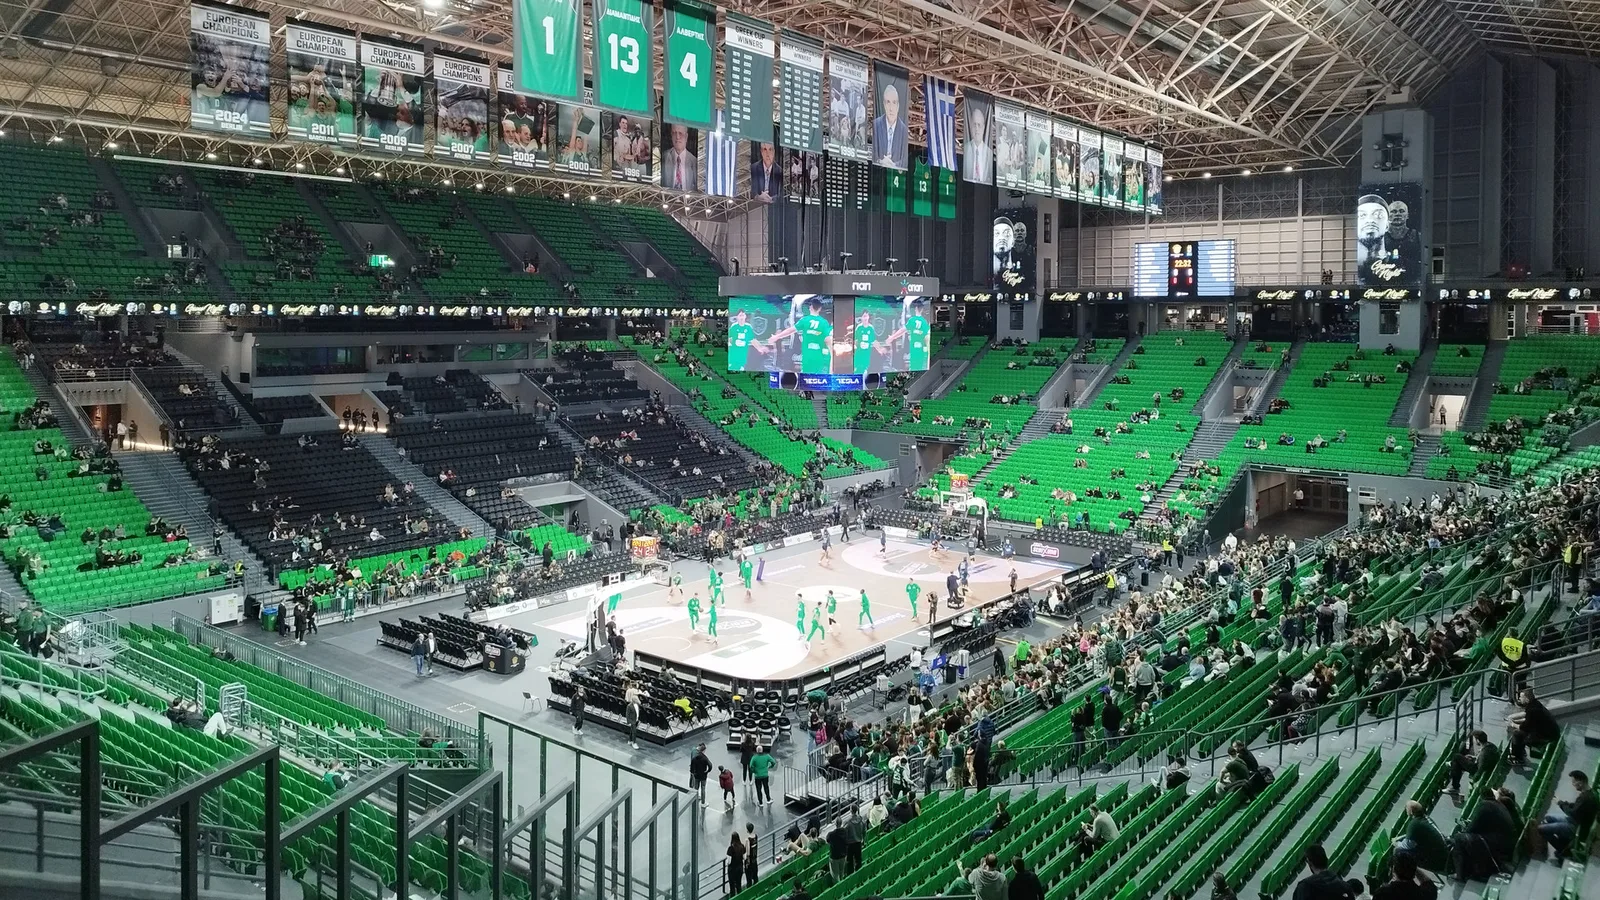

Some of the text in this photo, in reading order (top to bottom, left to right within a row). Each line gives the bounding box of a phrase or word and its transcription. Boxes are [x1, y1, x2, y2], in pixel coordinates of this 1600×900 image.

[206, 12, 256, 30] EUROPEAN
[202, 21, 260, 40] CHAMPIONS
[542, 16, 554, 55] 1
[735, 25, 766, 41] GREEK CUP
[299, 31, 344, 47] EUROPEAN
[737, 36, 764, 50] WINNERS
[296, 40, 347, 56] CHAMPIONS
[373, 47, 414, 62] EUROPEAN
[608, 33, 640, 74] 13
[370, 56, 416, 71] CHAMPIONS
[444, 61, 481, 75] EUROPEAN
[680, 52, 698, 87] 4
[441, 68, 483, 83] CHAMPIONS
[215, 109, 248, 125] 2024
[311, 123, 335, 136] 2011
[380, 134, 407, 146] 2009
[451, 142, 475, 154] 2007
[512, 151, 536, 163] 2002
[569, 160, 590, 171] 2000
[624, 167, 640, 178] 1996
[893, 175, 899, 188] 4
[919, 180, 927, 192] 13
[945, 184, 949, 196] 1
[1503, 645, 1519, 653] CSI
